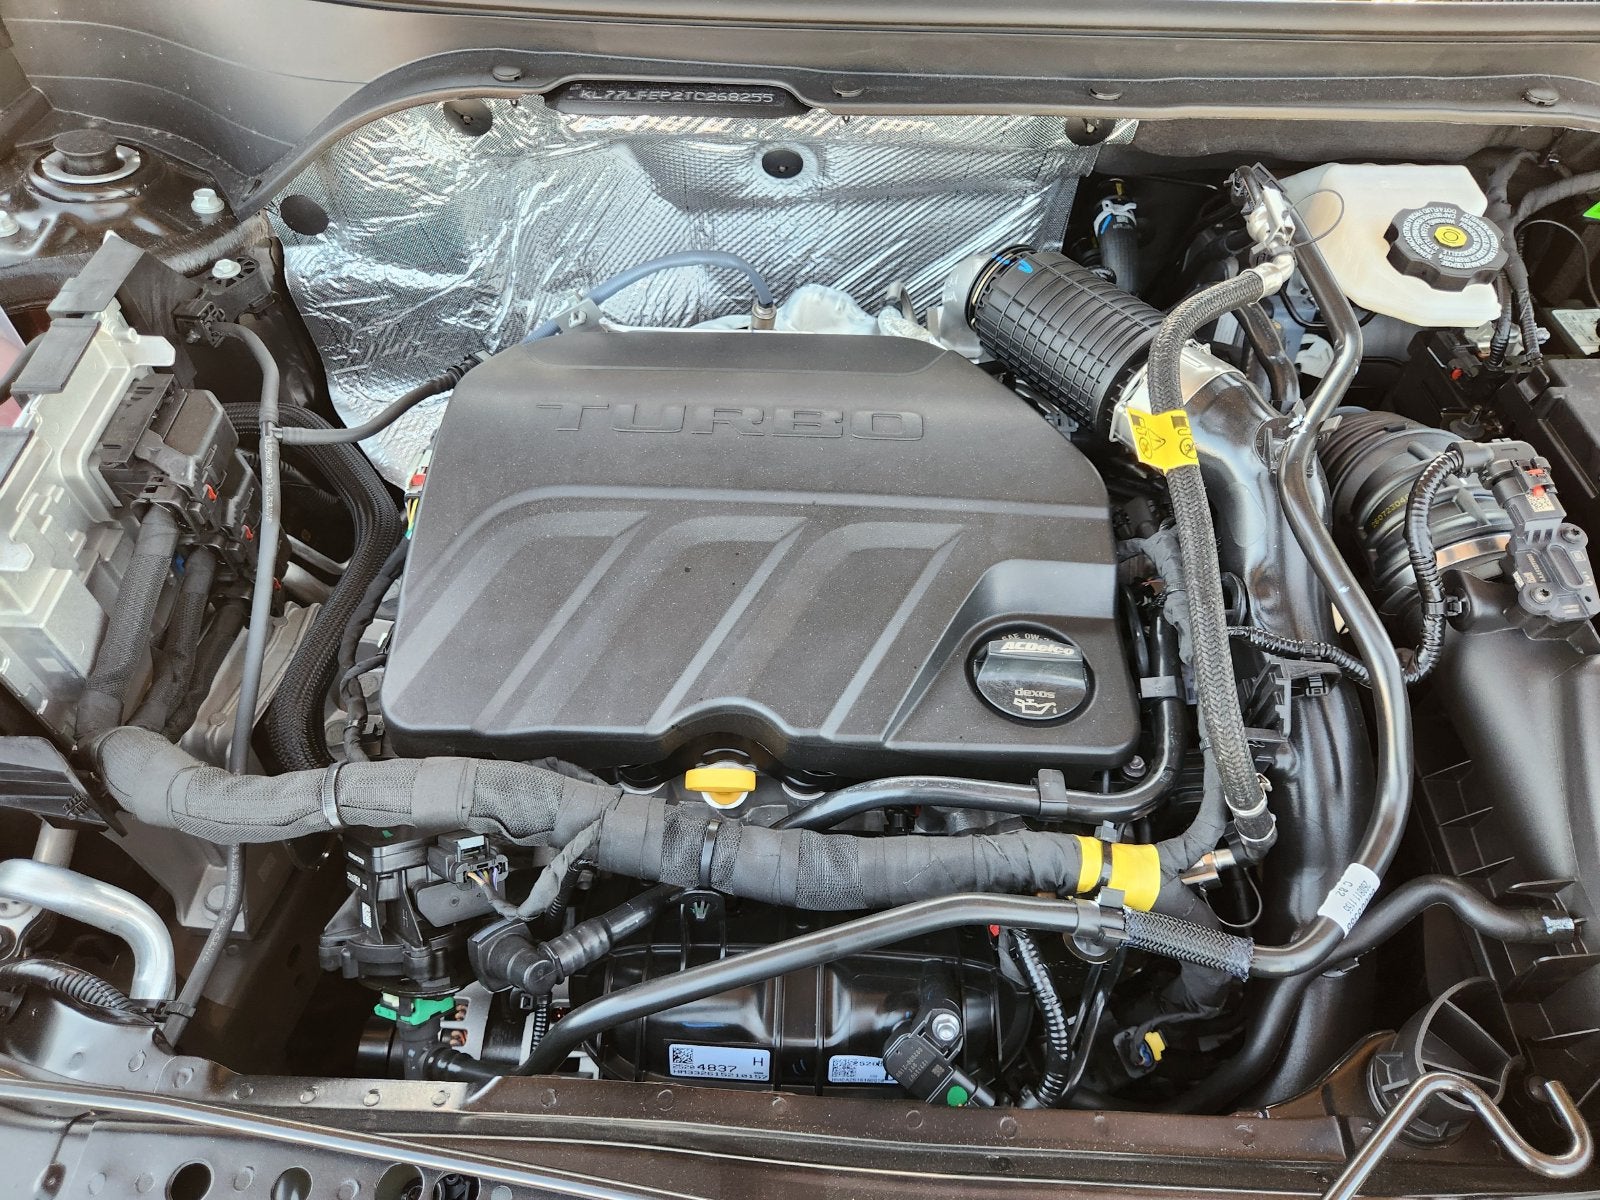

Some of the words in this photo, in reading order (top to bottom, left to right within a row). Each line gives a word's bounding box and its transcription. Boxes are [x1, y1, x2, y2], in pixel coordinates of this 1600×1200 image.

[536, 402, 924, 441] TURBO
[1001, 641, 1075, 656] ACDelco
[1015, 687, 1055, 699] dexos
[753, 1057, 764, 1066] H
[697, 1064, 737, 1072] 4837
